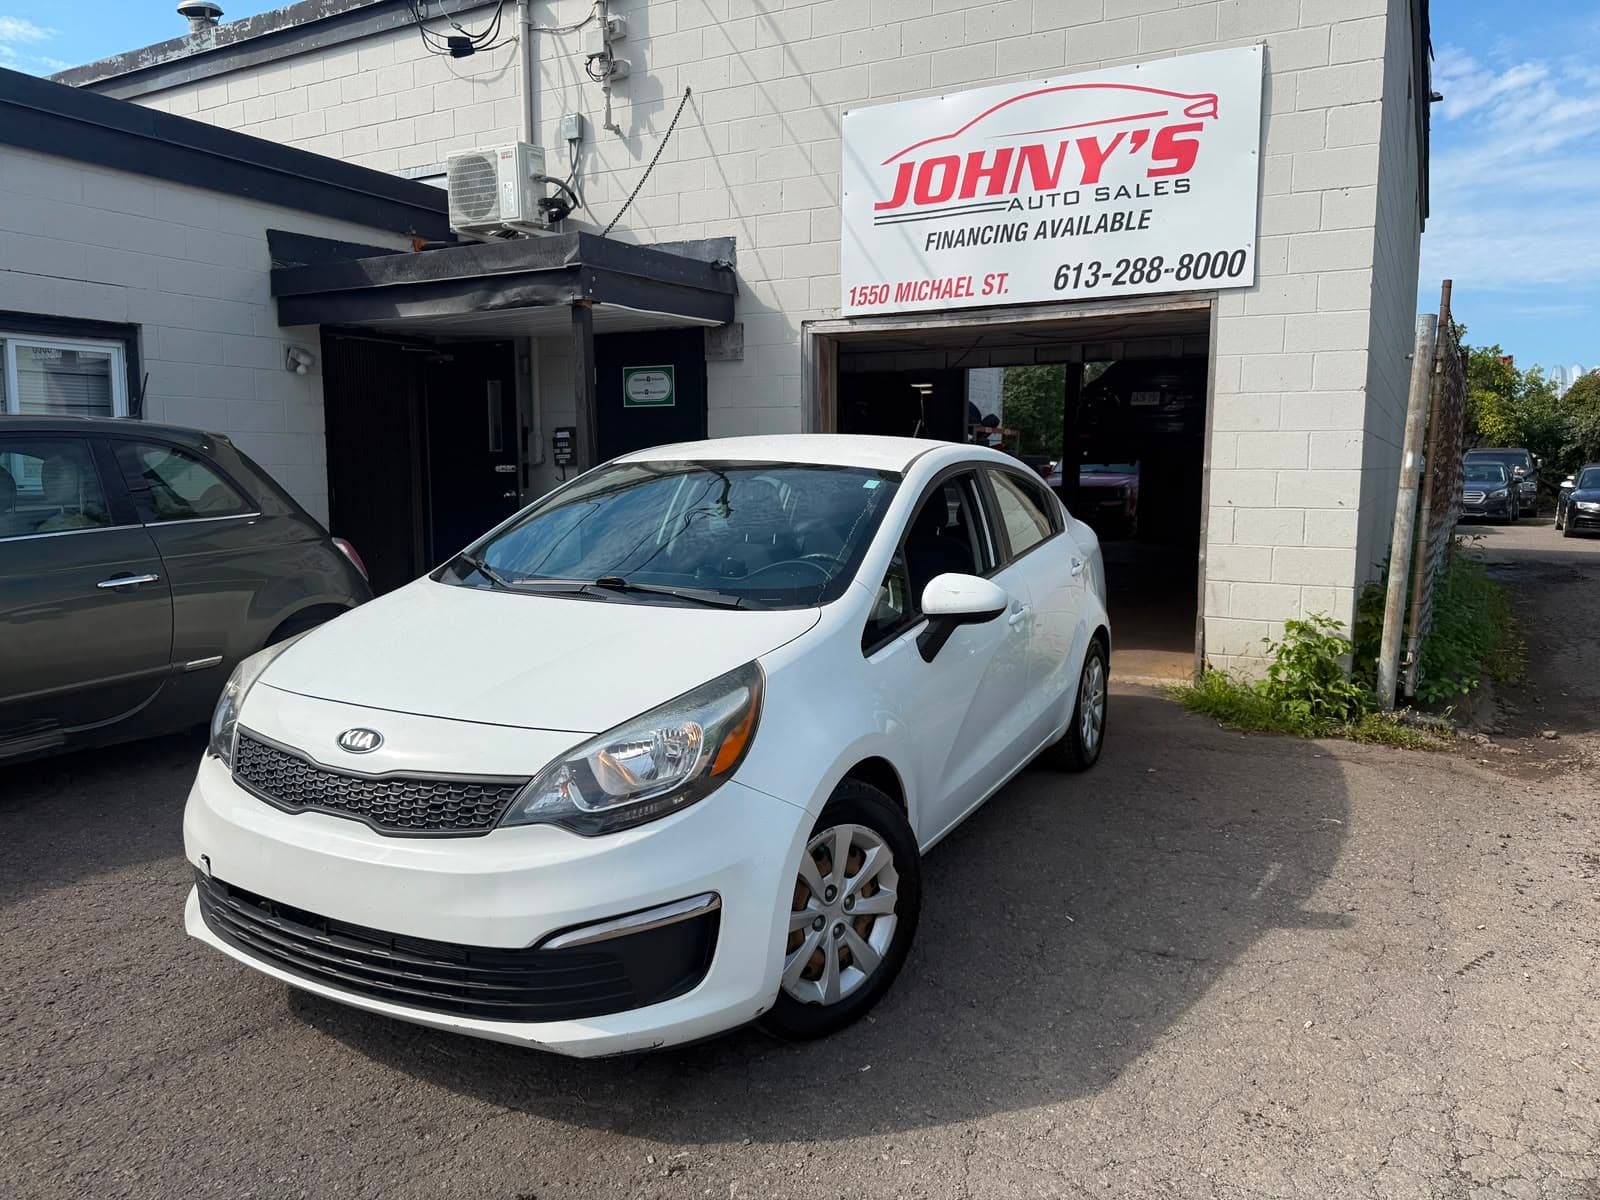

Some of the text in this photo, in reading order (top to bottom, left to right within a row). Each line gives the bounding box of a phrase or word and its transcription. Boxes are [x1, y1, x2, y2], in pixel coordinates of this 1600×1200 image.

[874, 122, 1204, 211] JOHNY'S
[1007, 178, 1191, 212] AUTO SALES
[925, 209, 1153, 252] FINANCING AVAILABLE
[1053, 249, 1247, 291] 613-288-8000
[849, 272, 1009, 307] 1550 MICHAEL ST.
[341, 730, 375, 749] KIA
